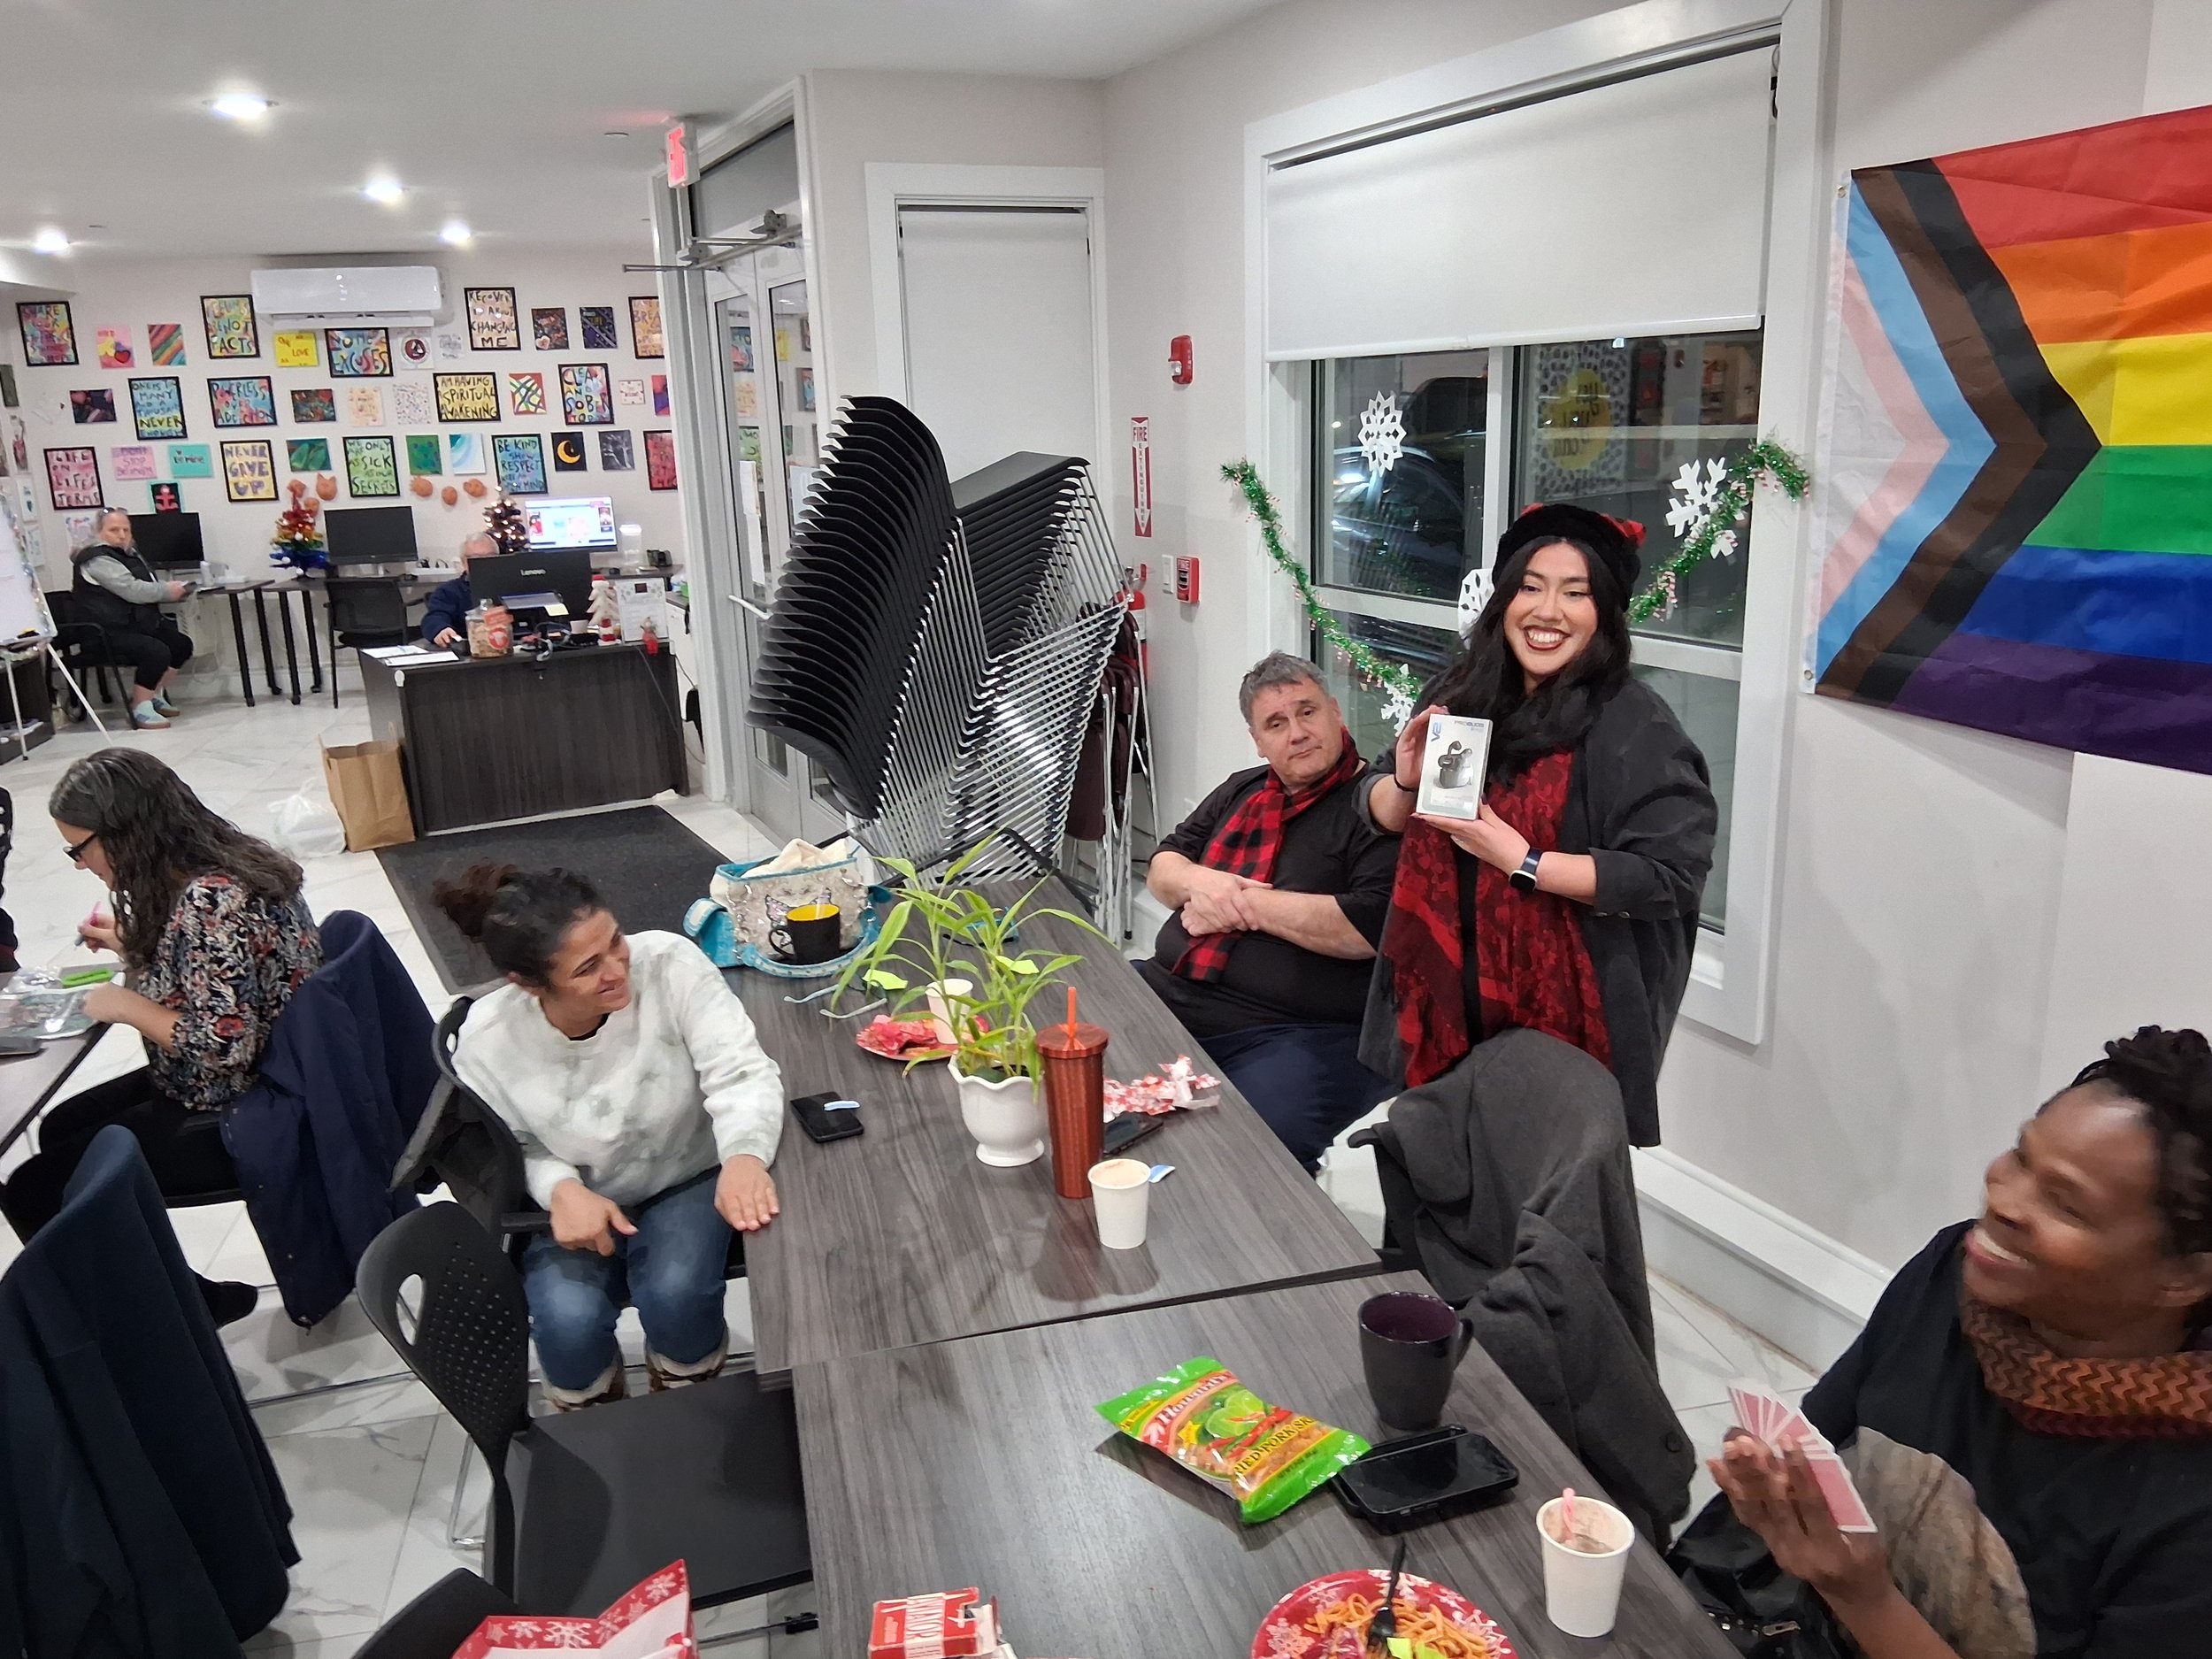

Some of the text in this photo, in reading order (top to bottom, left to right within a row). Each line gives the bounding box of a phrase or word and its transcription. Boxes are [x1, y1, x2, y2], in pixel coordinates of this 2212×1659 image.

[222, 316, 250, 334] NOT
[211, 334, 253, 354] FACTS
[481, 337, 508, 349] ME
[333, 347, 388, 375] EXCUSES
[455, 376, 490, 388] HAVING
[443, 387, 496, 405] SPIRITUAL
[440, 402, 498, 420] AWAKENING
[139, 415, 183, 428] NEVER
[225, 444, 268, 458] NEVER
[365, 440, 391, 452] ONLY
[497, 439, 538, 454] BE KIND
[229, 461, 270, 477] GIVE
[361, 454, 392, 471] SICK
[501, 459, 540, 473] RESPECT
[234, 480, 265, 496] UP
[58, 491, 100, 506] TERMS
[1260, 1428, 1295, 1454] PORK
